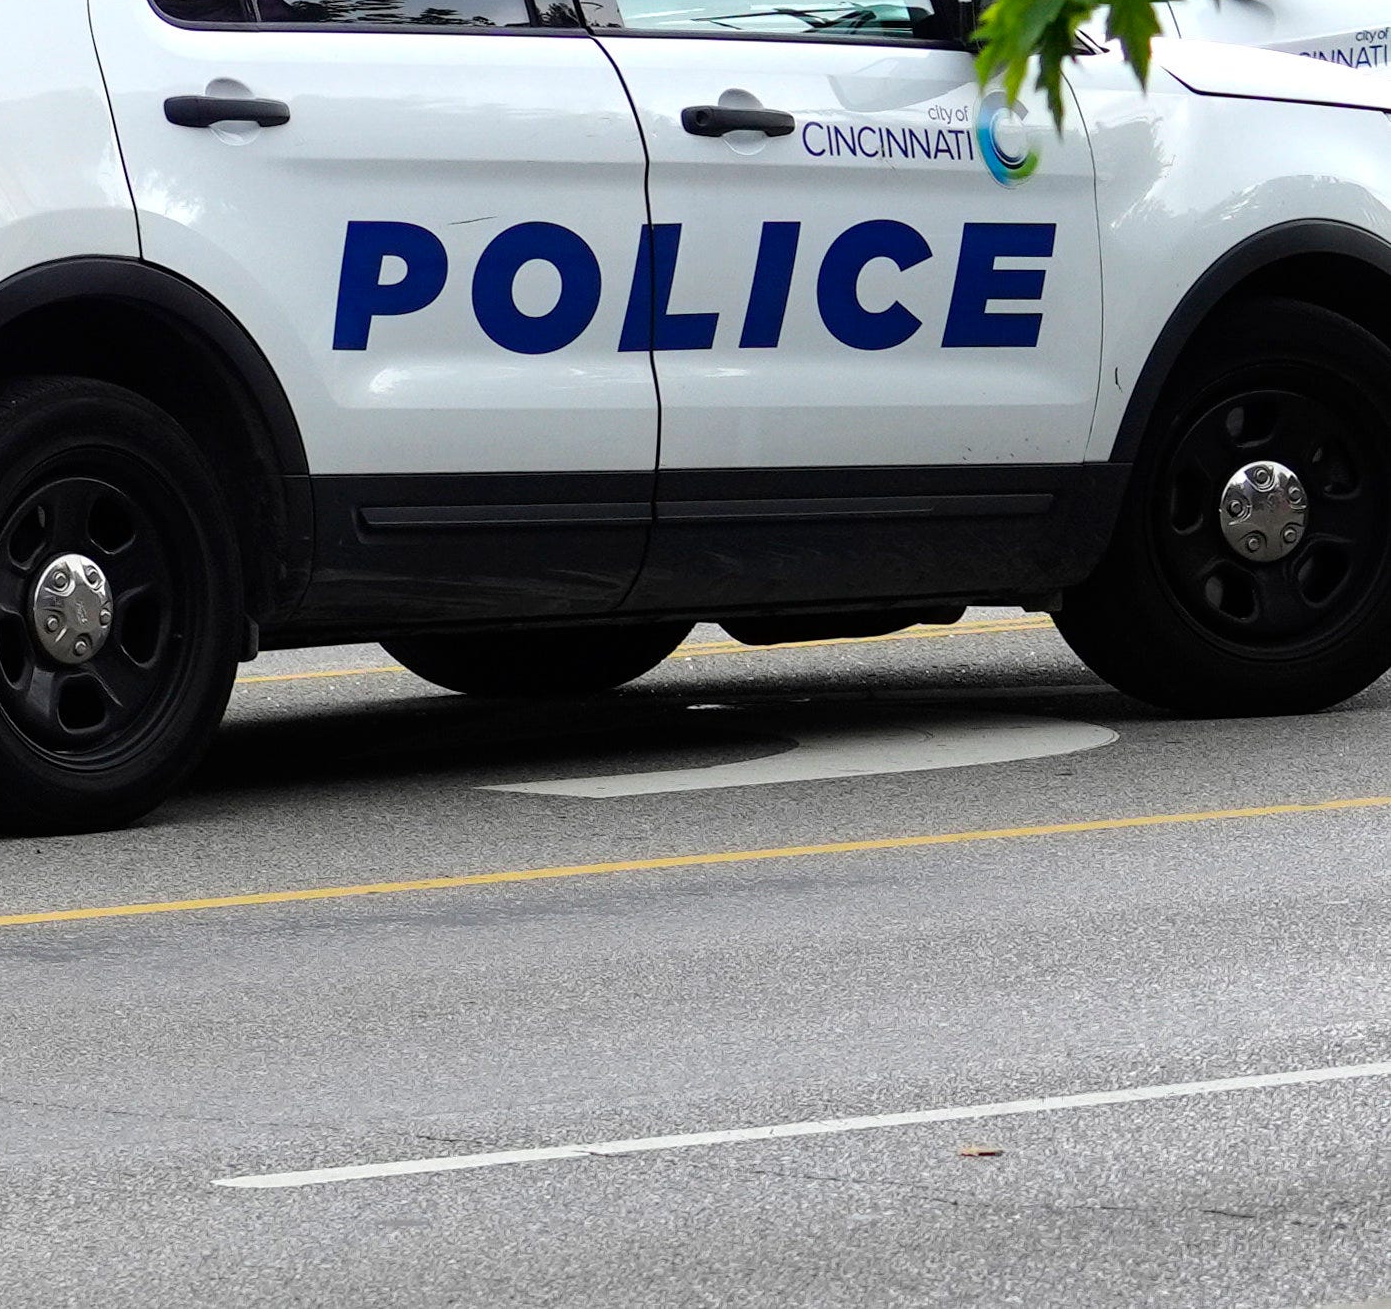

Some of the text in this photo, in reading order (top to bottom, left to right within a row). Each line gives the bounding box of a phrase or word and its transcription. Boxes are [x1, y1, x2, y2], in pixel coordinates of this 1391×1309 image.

[1355, 26, 1390, 44] city of
[927, 104, 969, 125] city of
[801, 121, 975, 161] CINCINNATI
[331, 218, 1058, 355] POLICE
